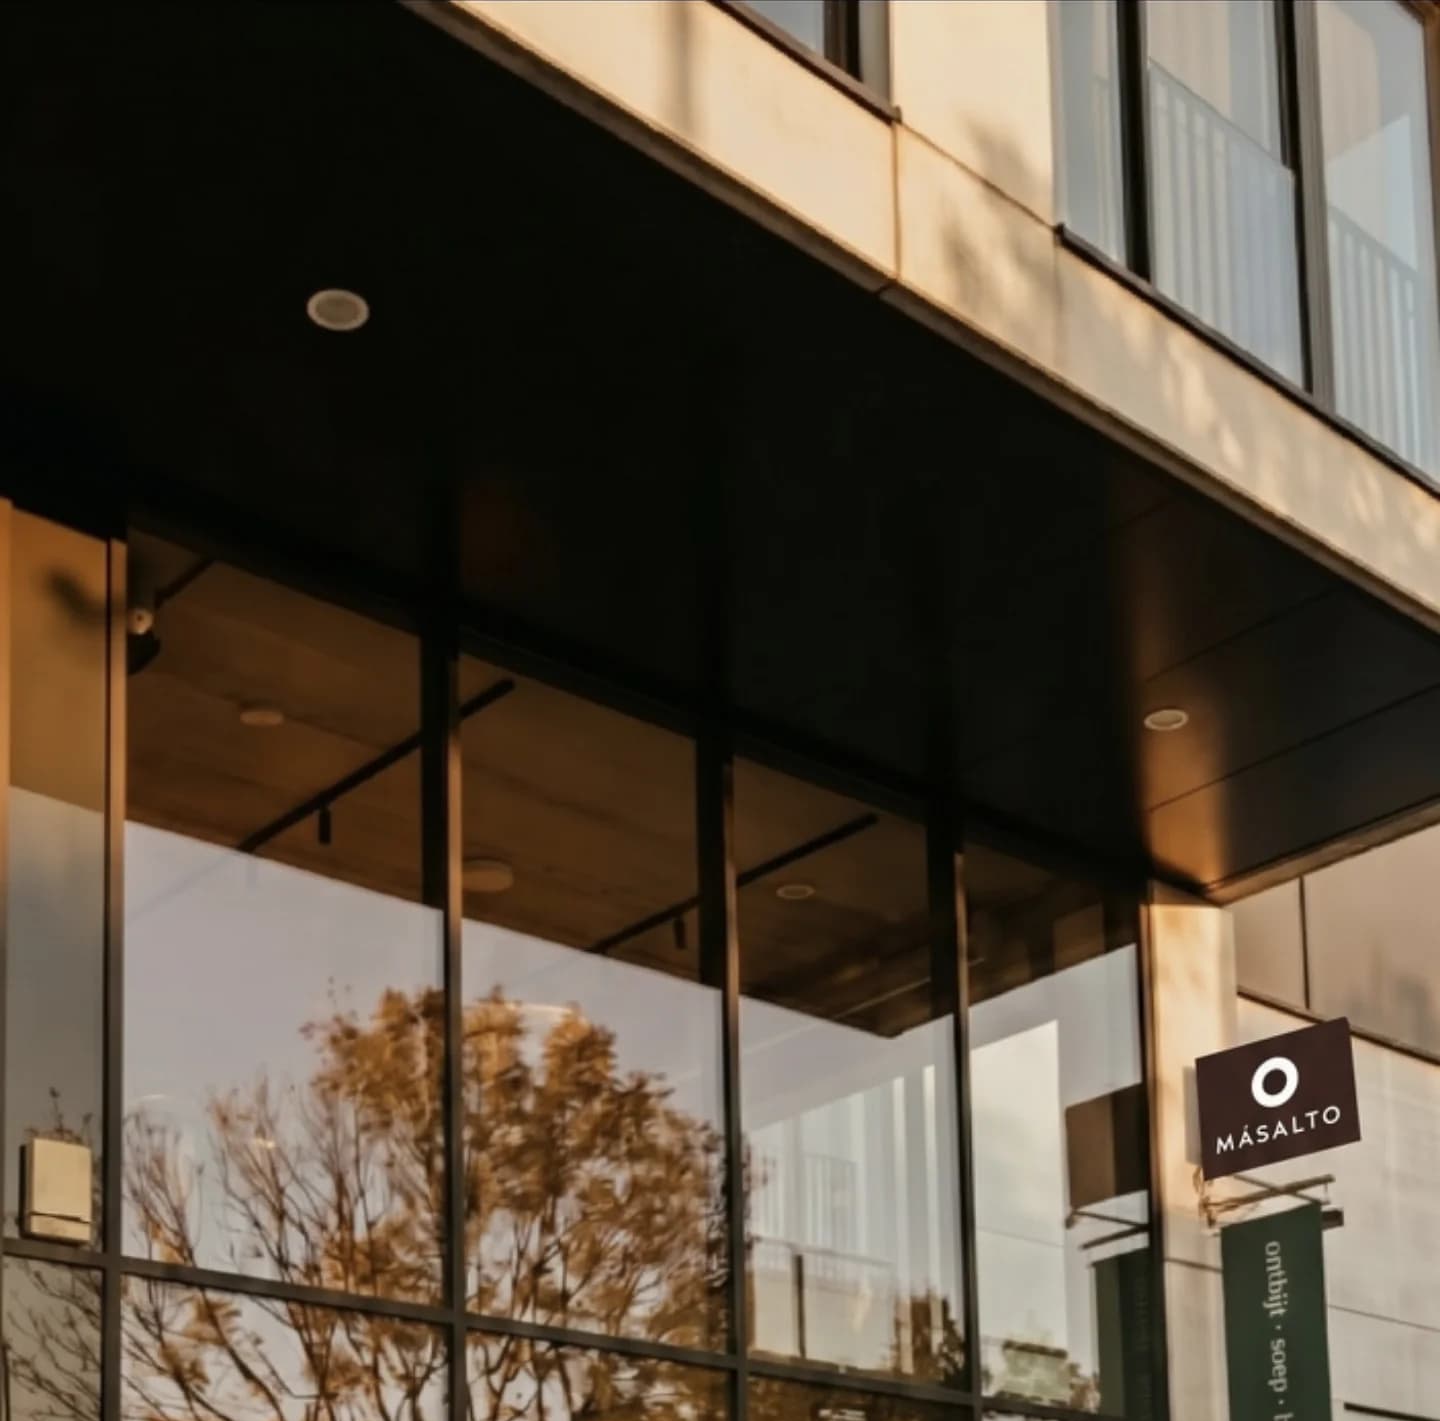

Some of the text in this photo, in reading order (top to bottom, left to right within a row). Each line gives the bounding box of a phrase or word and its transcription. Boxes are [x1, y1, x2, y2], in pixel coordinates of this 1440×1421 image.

[1216, 1105, 1341, 1154] MÁSALTO
[1262, 1239, 1290, 1320] ontbijt
[1266, 1336, 1289, 1394] soep
